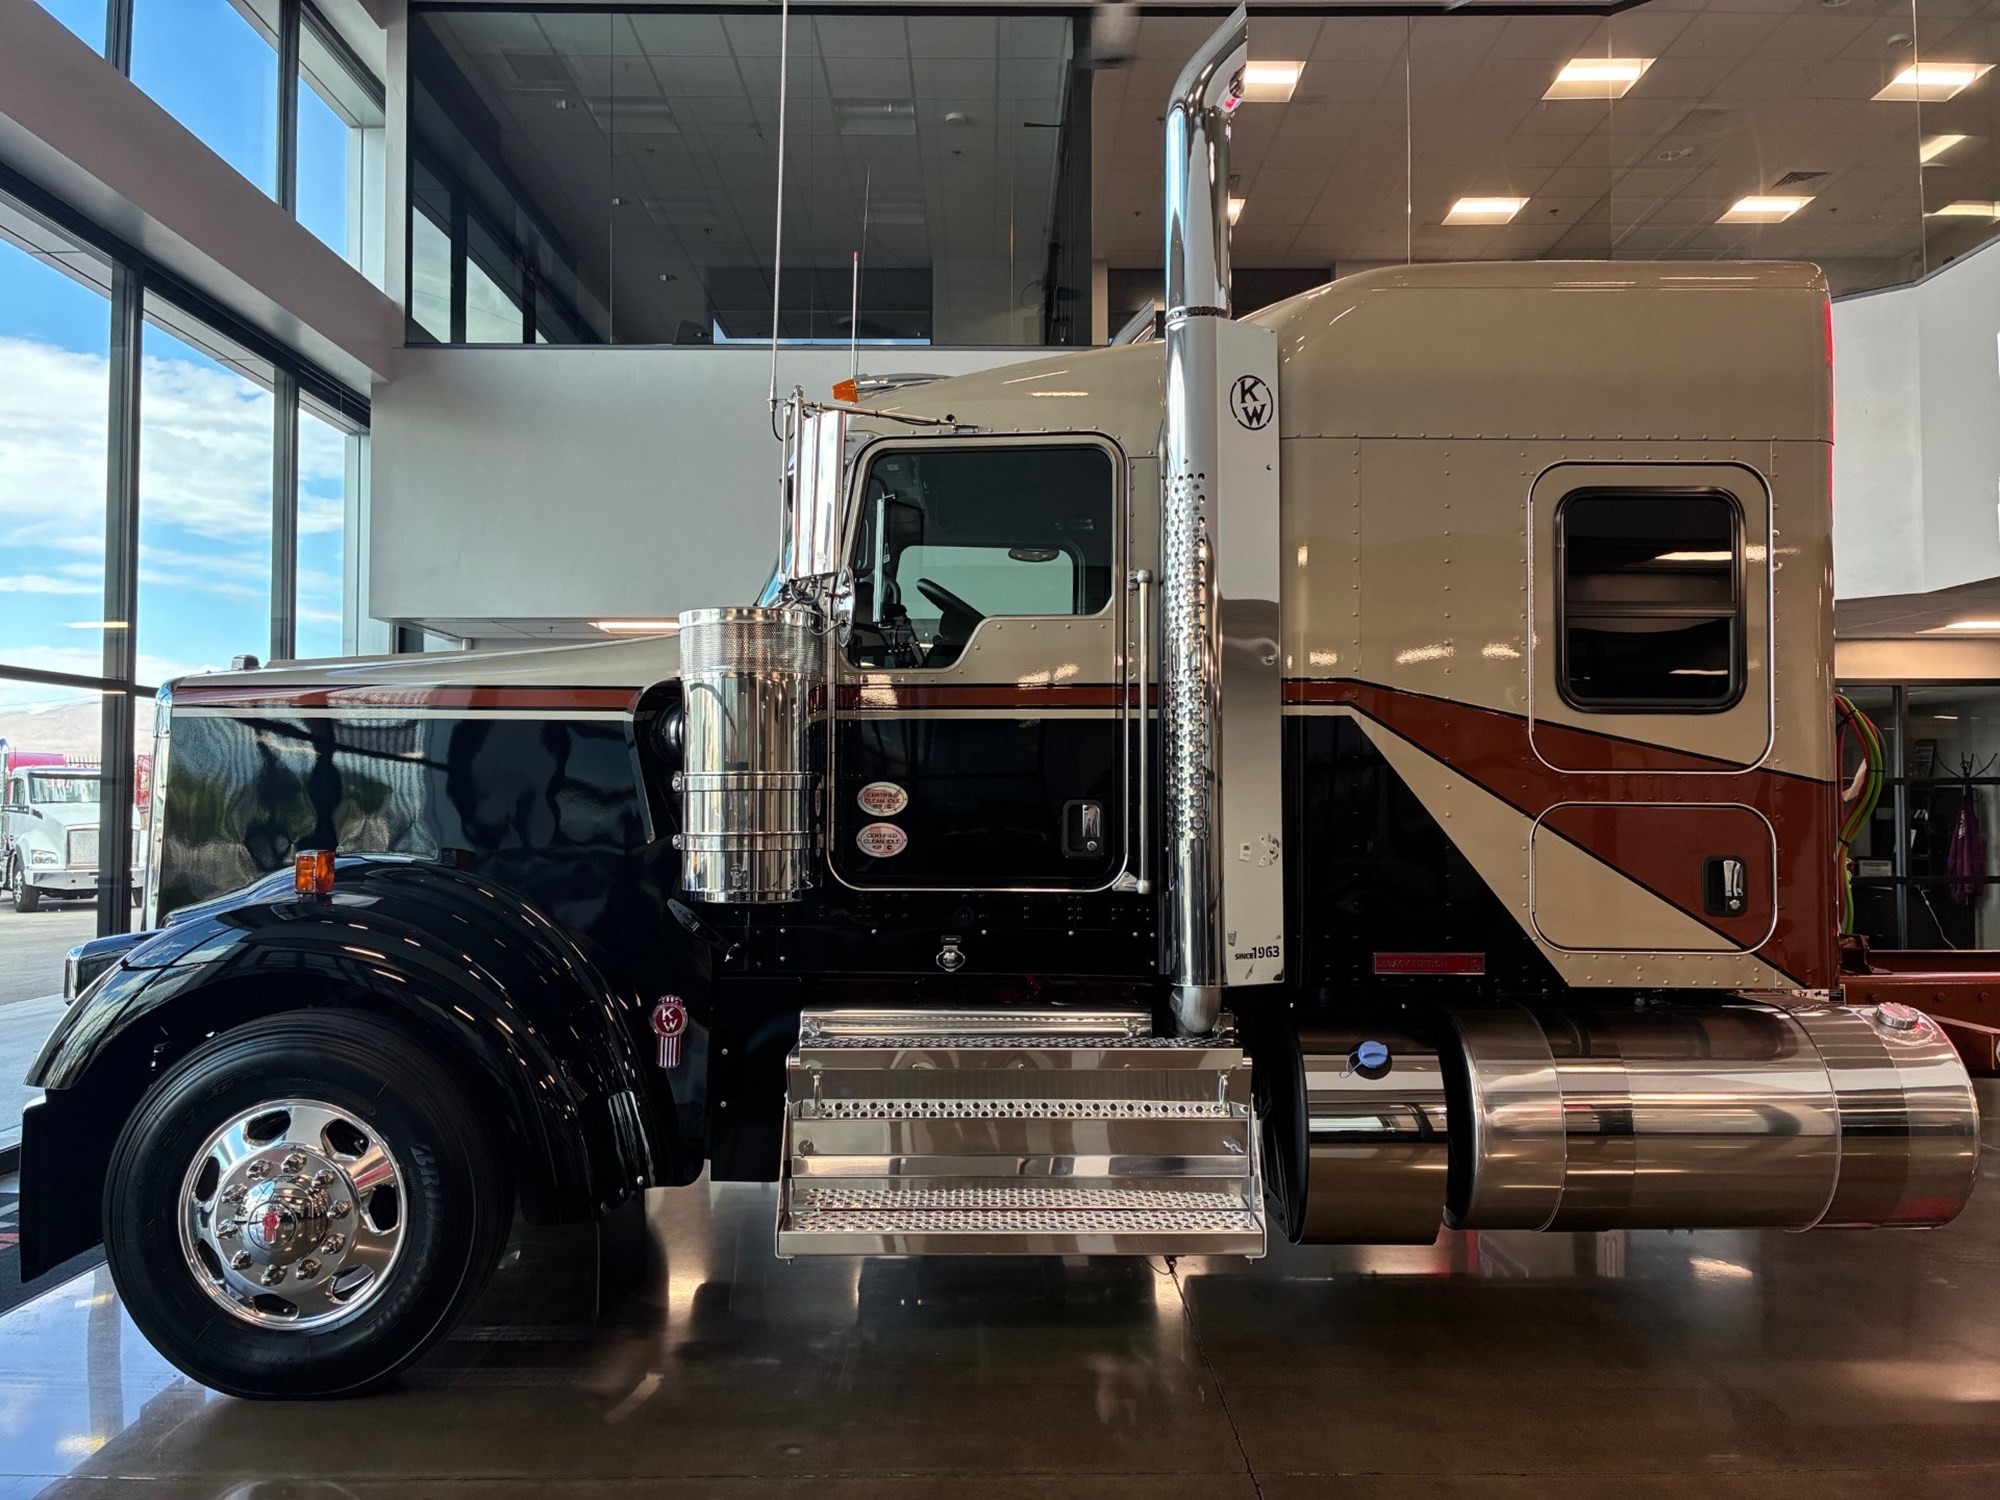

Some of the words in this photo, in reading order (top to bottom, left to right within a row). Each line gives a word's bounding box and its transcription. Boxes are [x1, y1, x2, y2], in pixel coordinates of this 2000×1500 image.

[1251, 945, 1280, 959] 1963
[1377, 959, 1411, 969] LEGACY
[1411, 959, 1449, 969] EDITION
